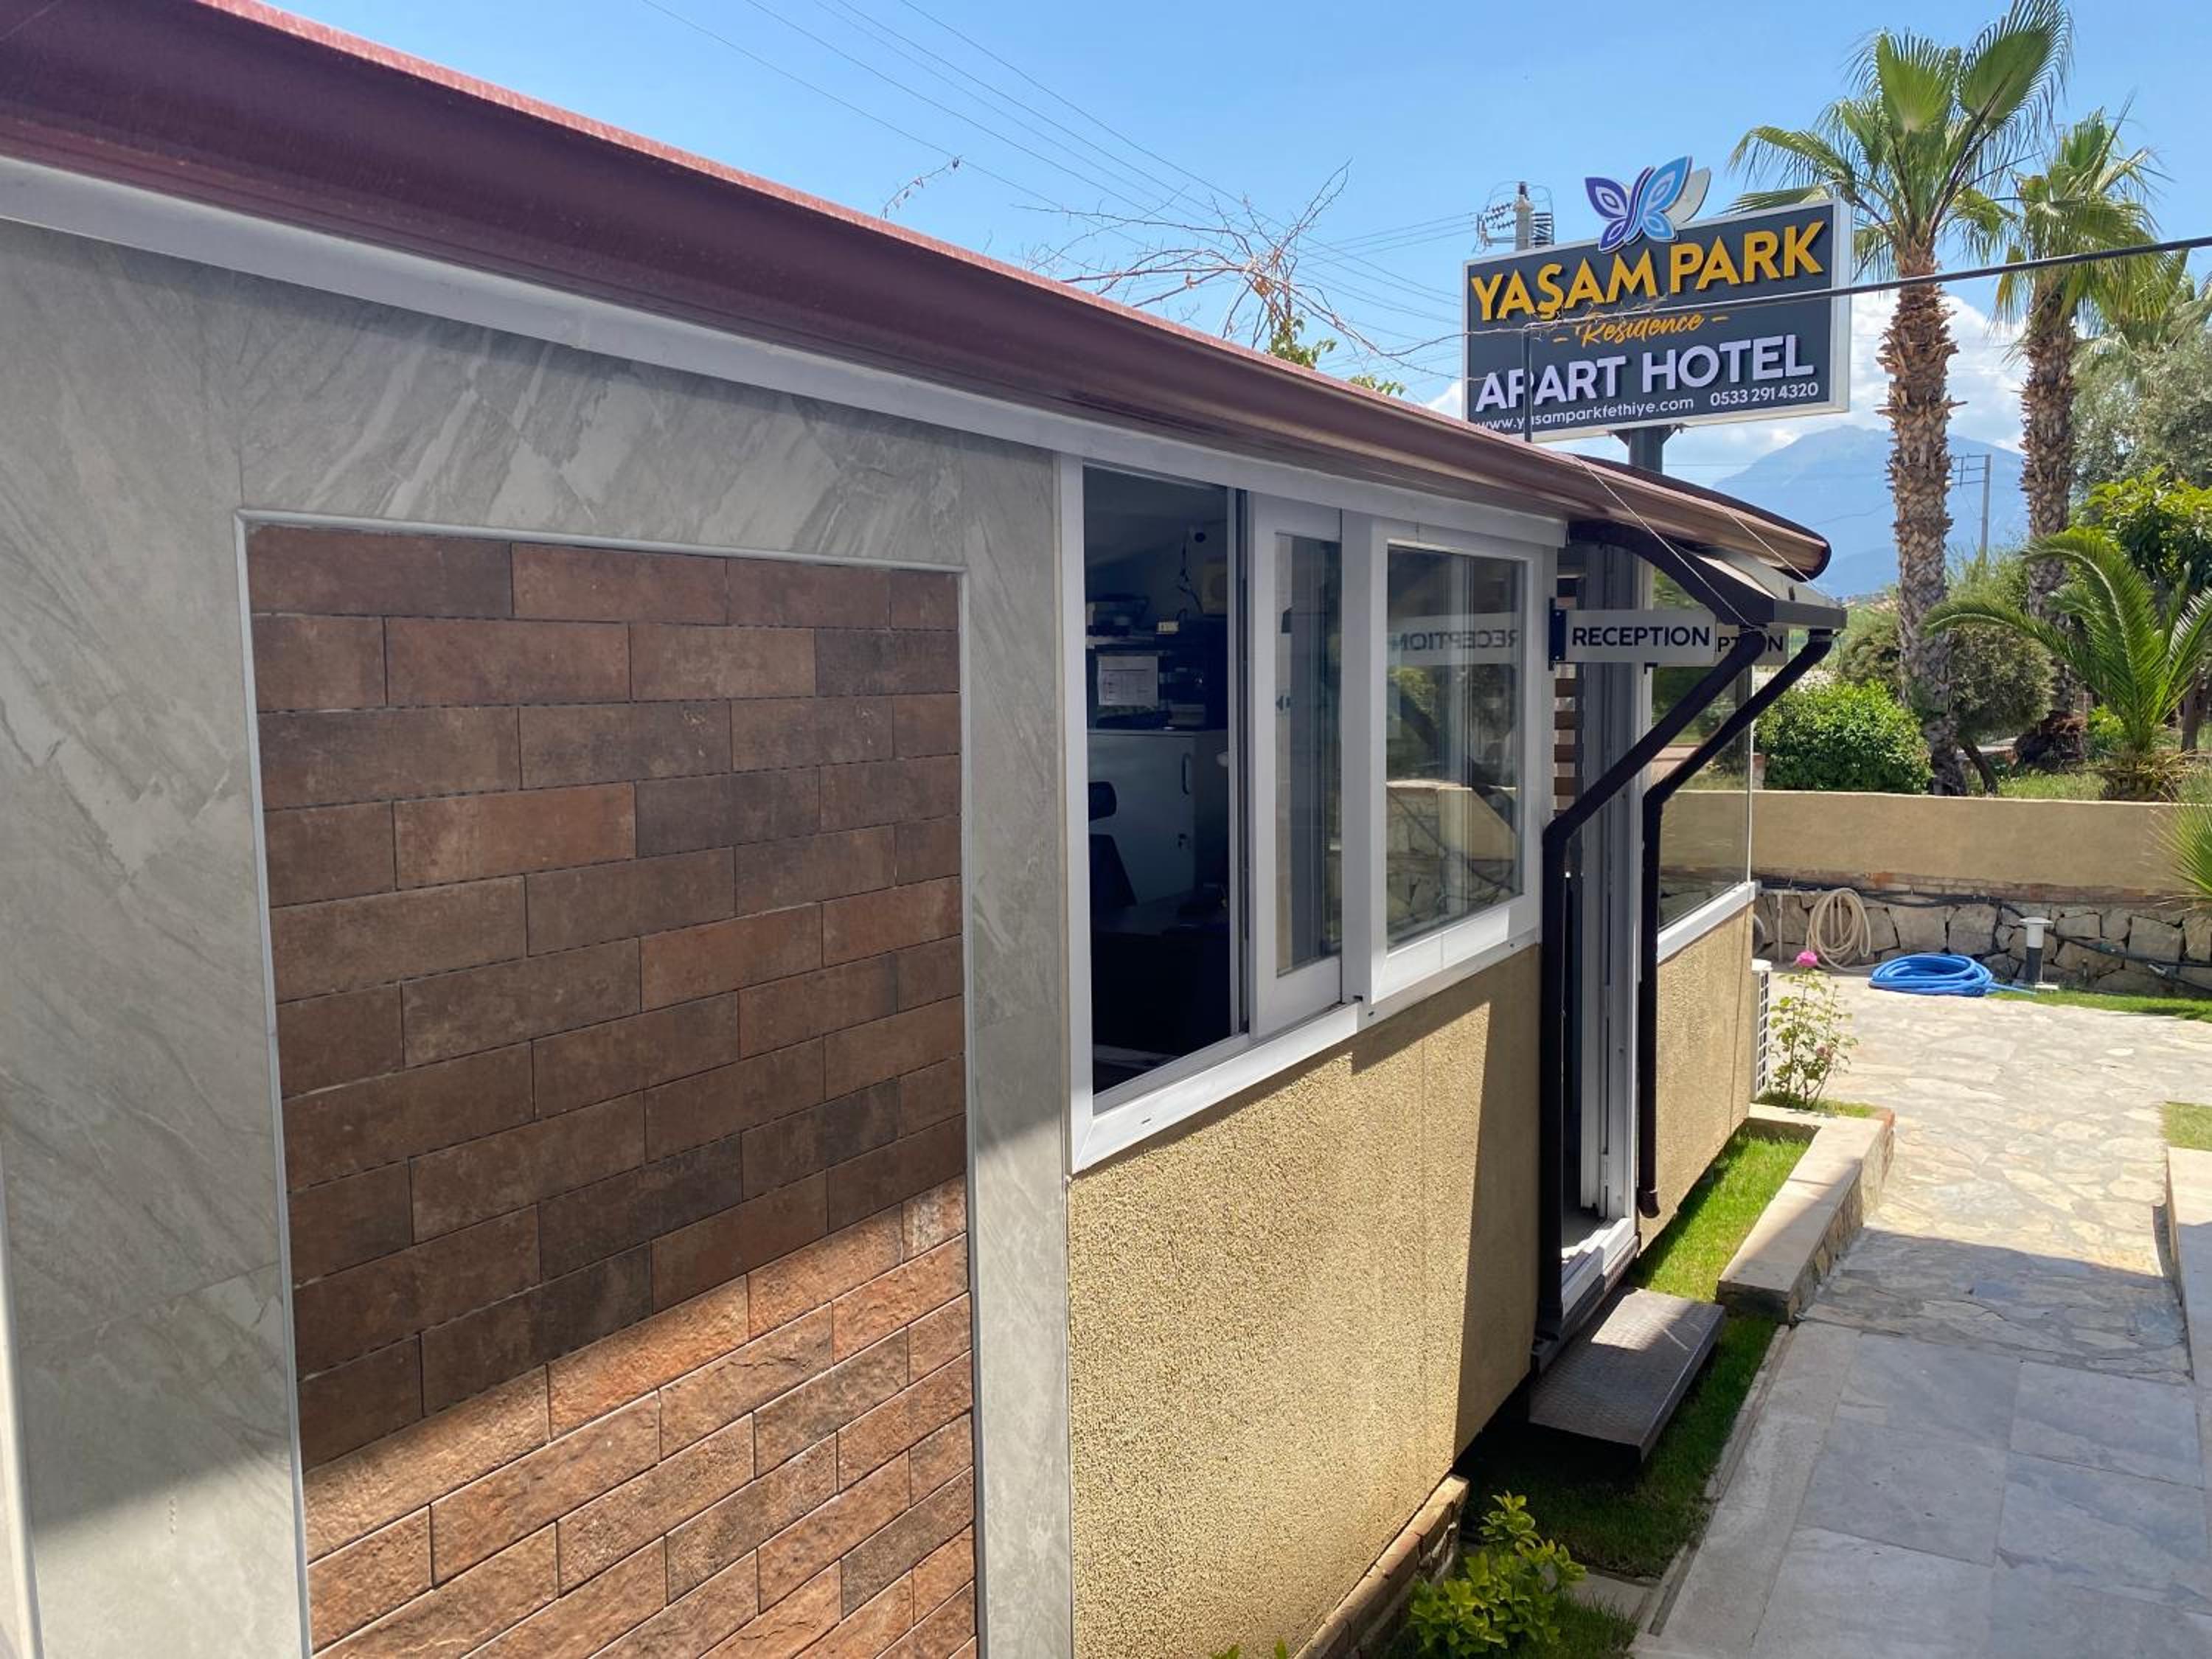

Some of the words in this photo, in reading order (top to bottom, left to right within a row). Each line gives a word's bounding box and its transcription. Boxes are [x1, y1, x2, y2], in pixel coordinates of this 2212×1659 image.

[1471, 248, 1658, 321] YAŞAM
[1670, 220, 1826, 294] PARK
[1575, 311, 1705, 347] Residence
[1475, 356, 1627, 412] APART
[1642, 334, 1815, 394] HOTEL
[1476, 397, 1693, 429] www.ysamparkfethiye.com
[1710, 389, 1748, 406] 0533
[1572, 626, 1710, 647] RECEPTION
